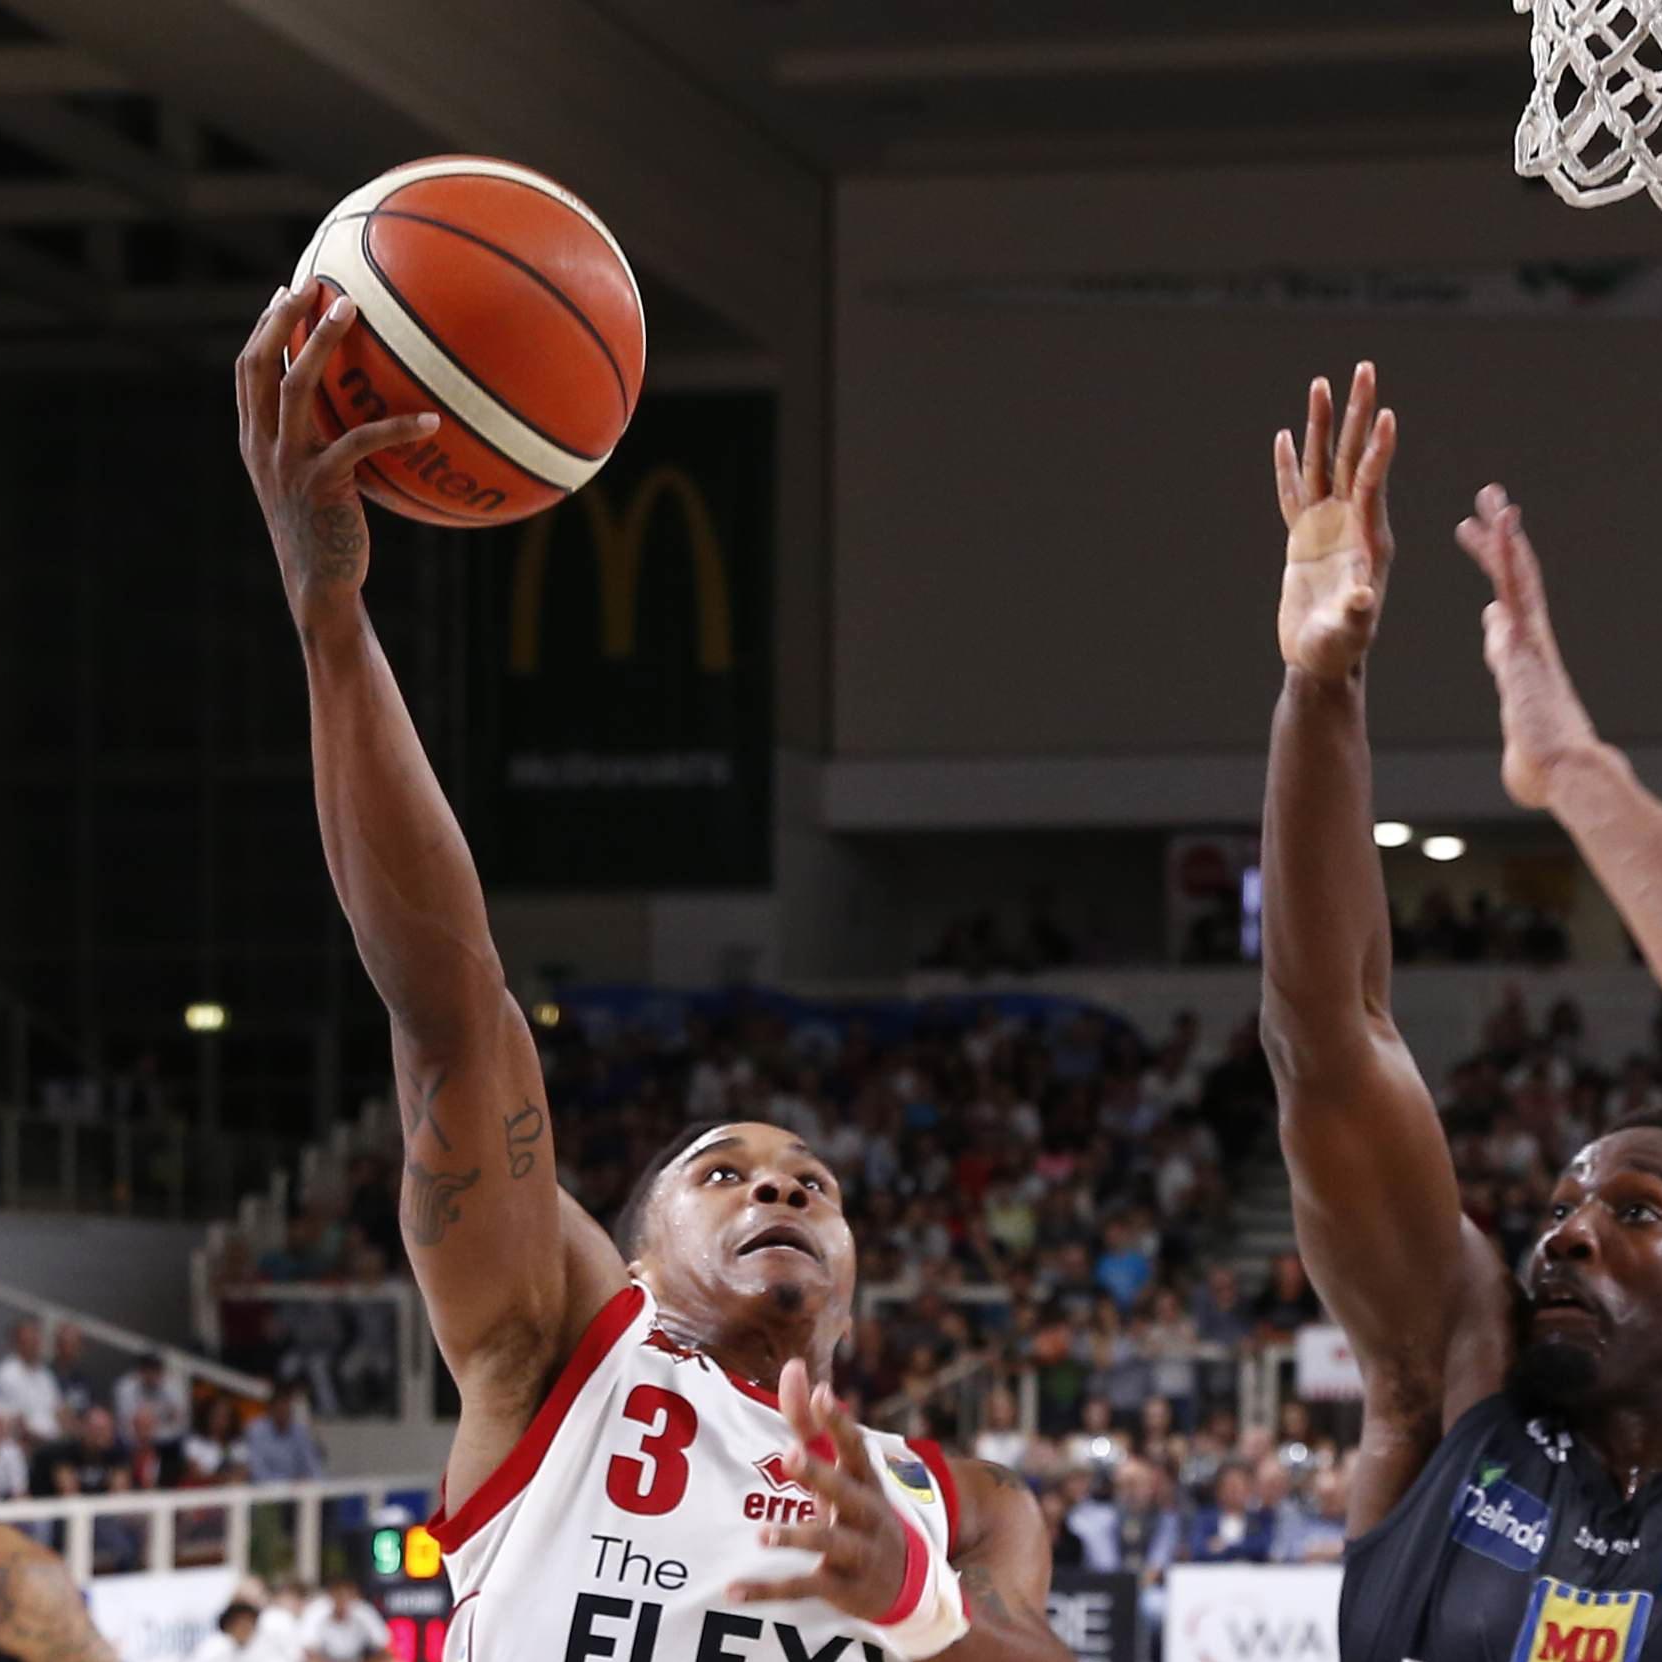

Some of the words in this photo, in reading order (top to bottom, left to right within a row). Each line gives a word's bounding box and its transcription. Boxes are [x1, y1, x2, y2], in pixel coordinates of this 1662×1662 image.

[339, 367, 507, 513] mlten
[605, 1383, 698, 1517] 3
[743, 1491, 818, 1525] erre
[590, 1534, 688, 1590] The
